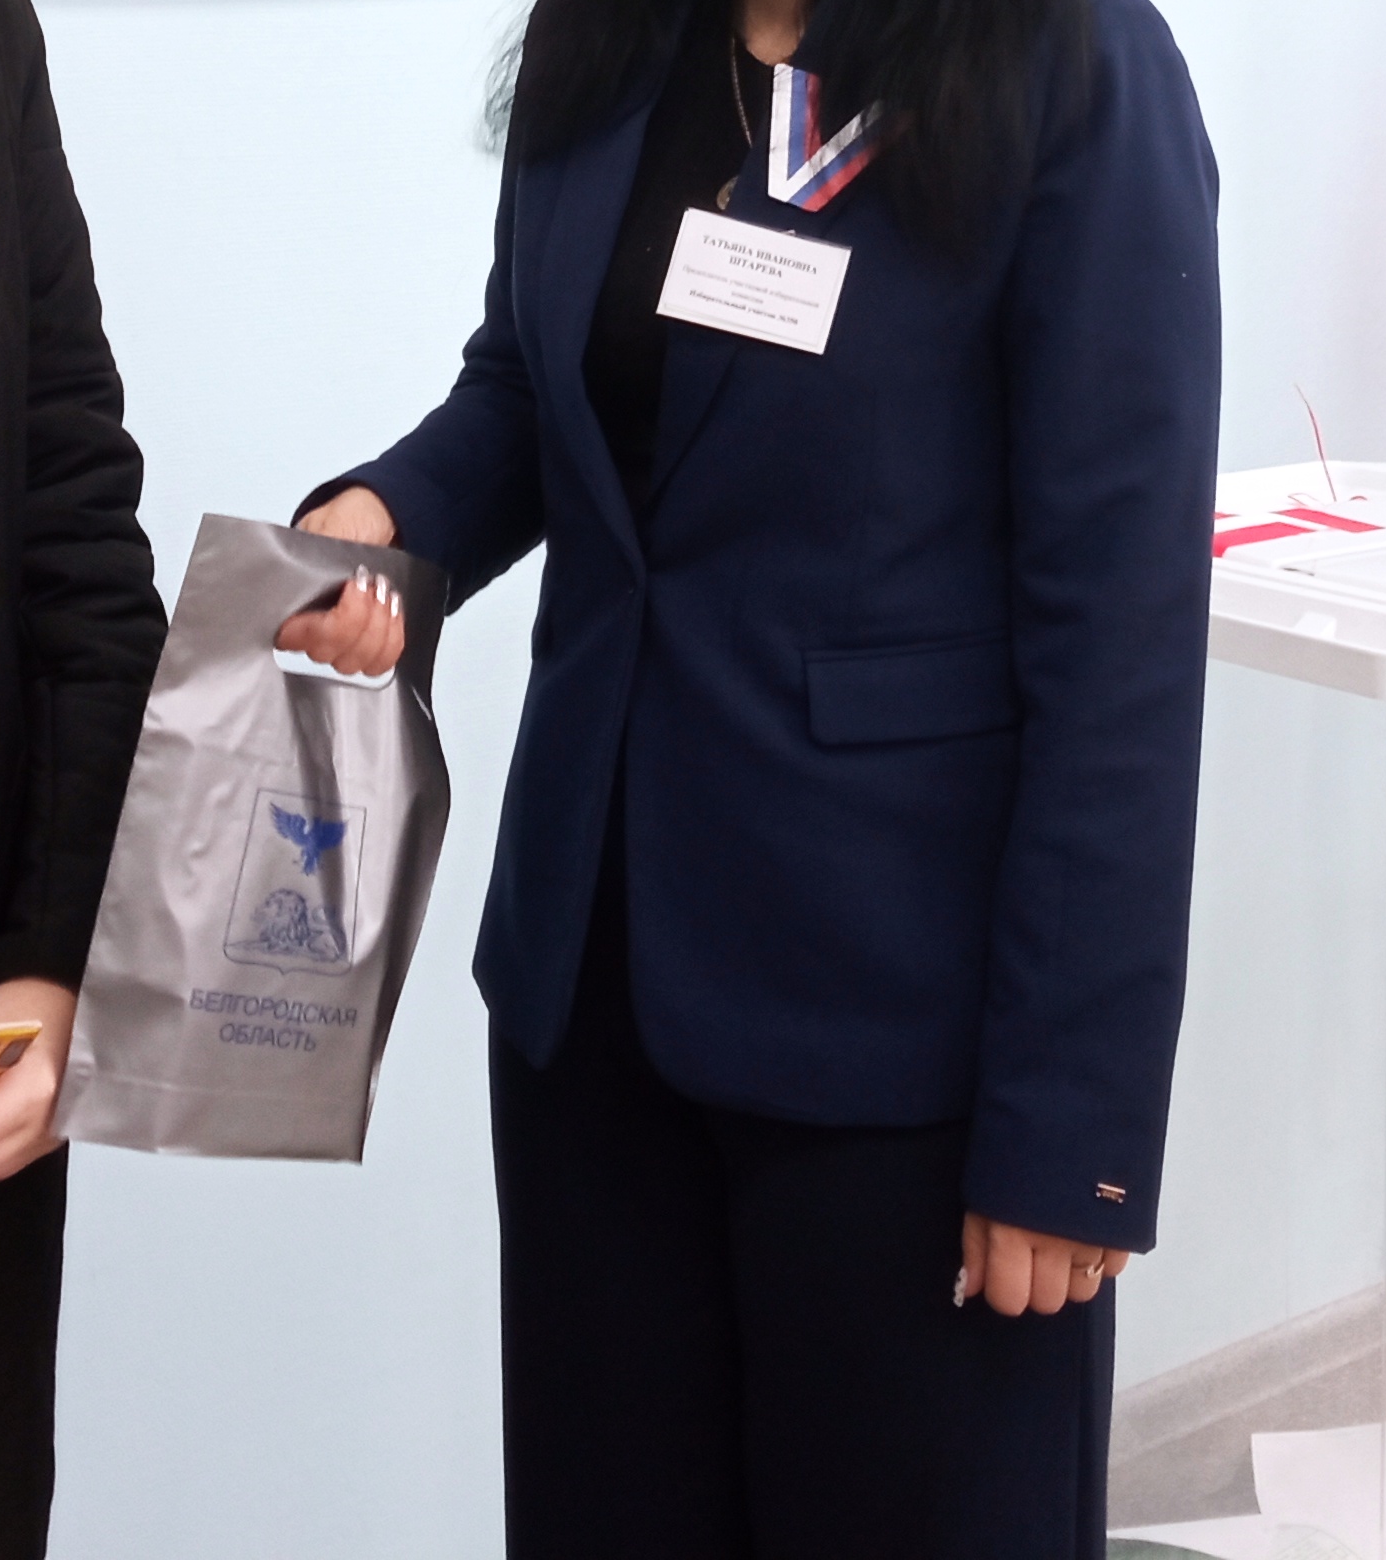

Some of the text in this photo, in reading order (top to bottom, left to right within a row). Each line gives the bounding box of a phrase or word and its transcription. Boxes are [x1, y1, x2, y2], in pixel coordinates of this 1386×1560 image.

[702, 234, 818, 275] ТАТЬЯНА ИВАНОВНА
[729, 256, 783, 278] ШТАРЕВА
[190, 988, 357, 1028] БЕЛГОРОДСКАЯ
[219, 1022, 317, 1052] ОБЛАСТЬ
